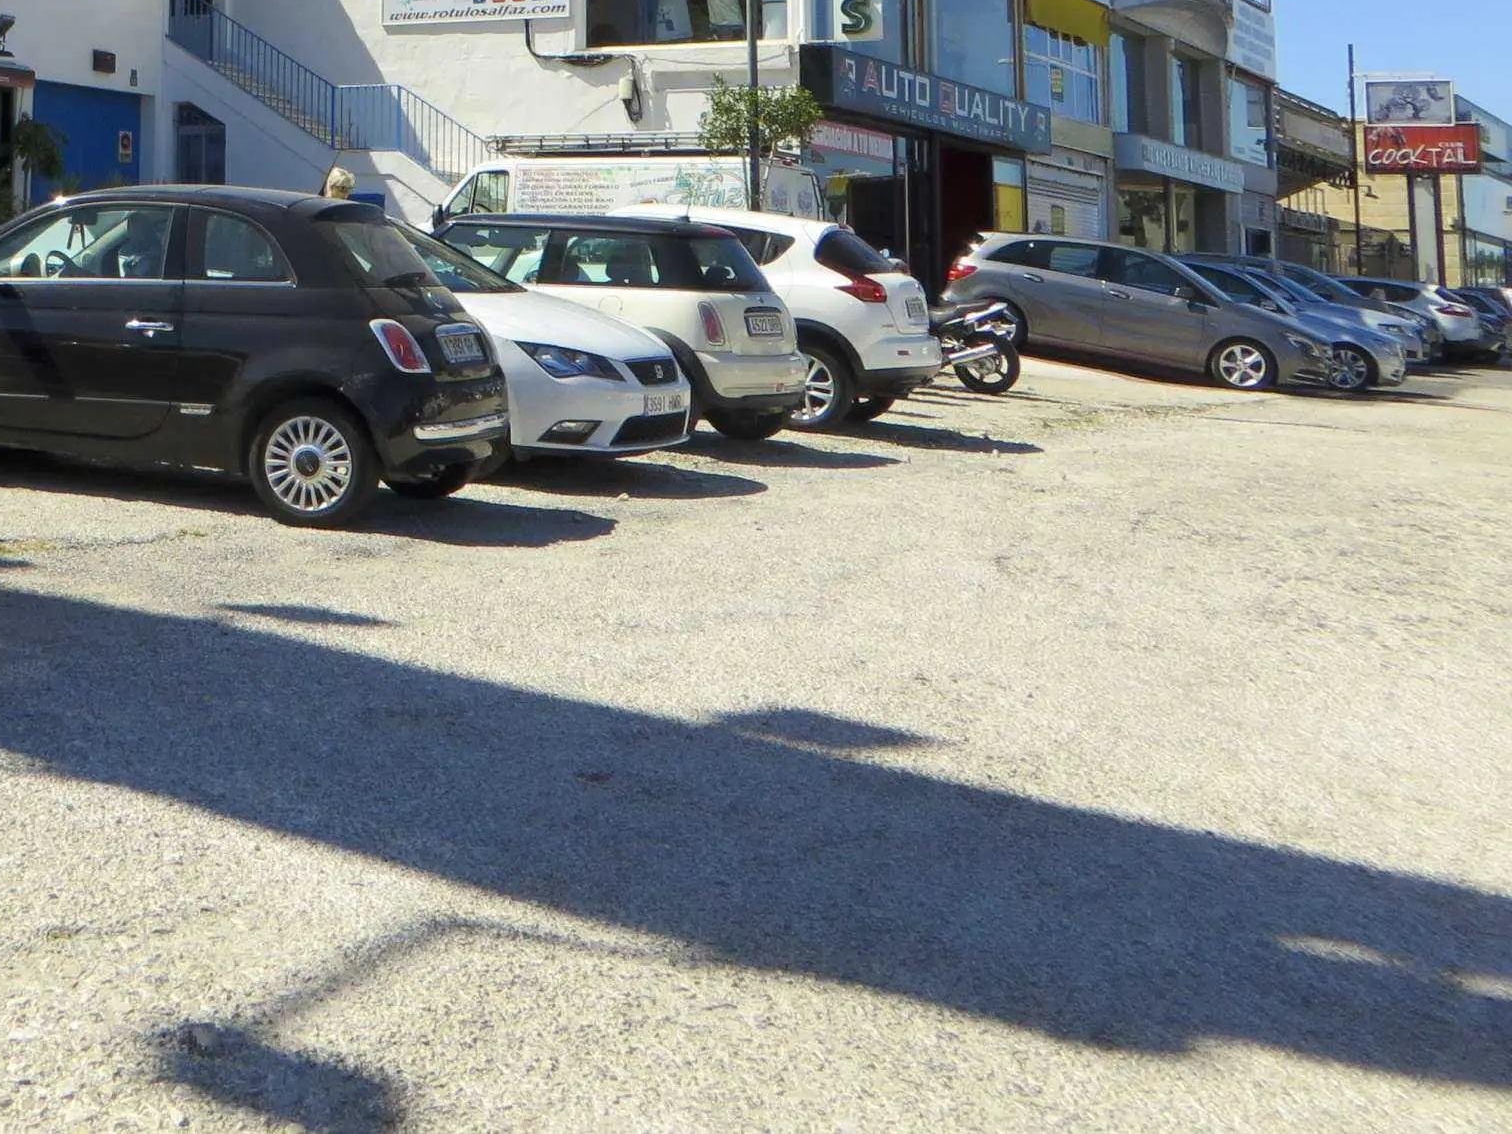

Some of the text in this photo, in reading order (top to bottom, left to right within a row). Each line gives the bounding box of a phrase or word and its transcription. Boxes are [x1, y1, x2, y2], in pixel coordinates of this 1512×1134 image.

[389, 3, 567, 22] www.rotulosalfaz.com
[863, 61, 930, 107] AUTO
[940, 81, 1030, 132] QUALITY
[1368, 144, 1477, 167] COCKTAIL
